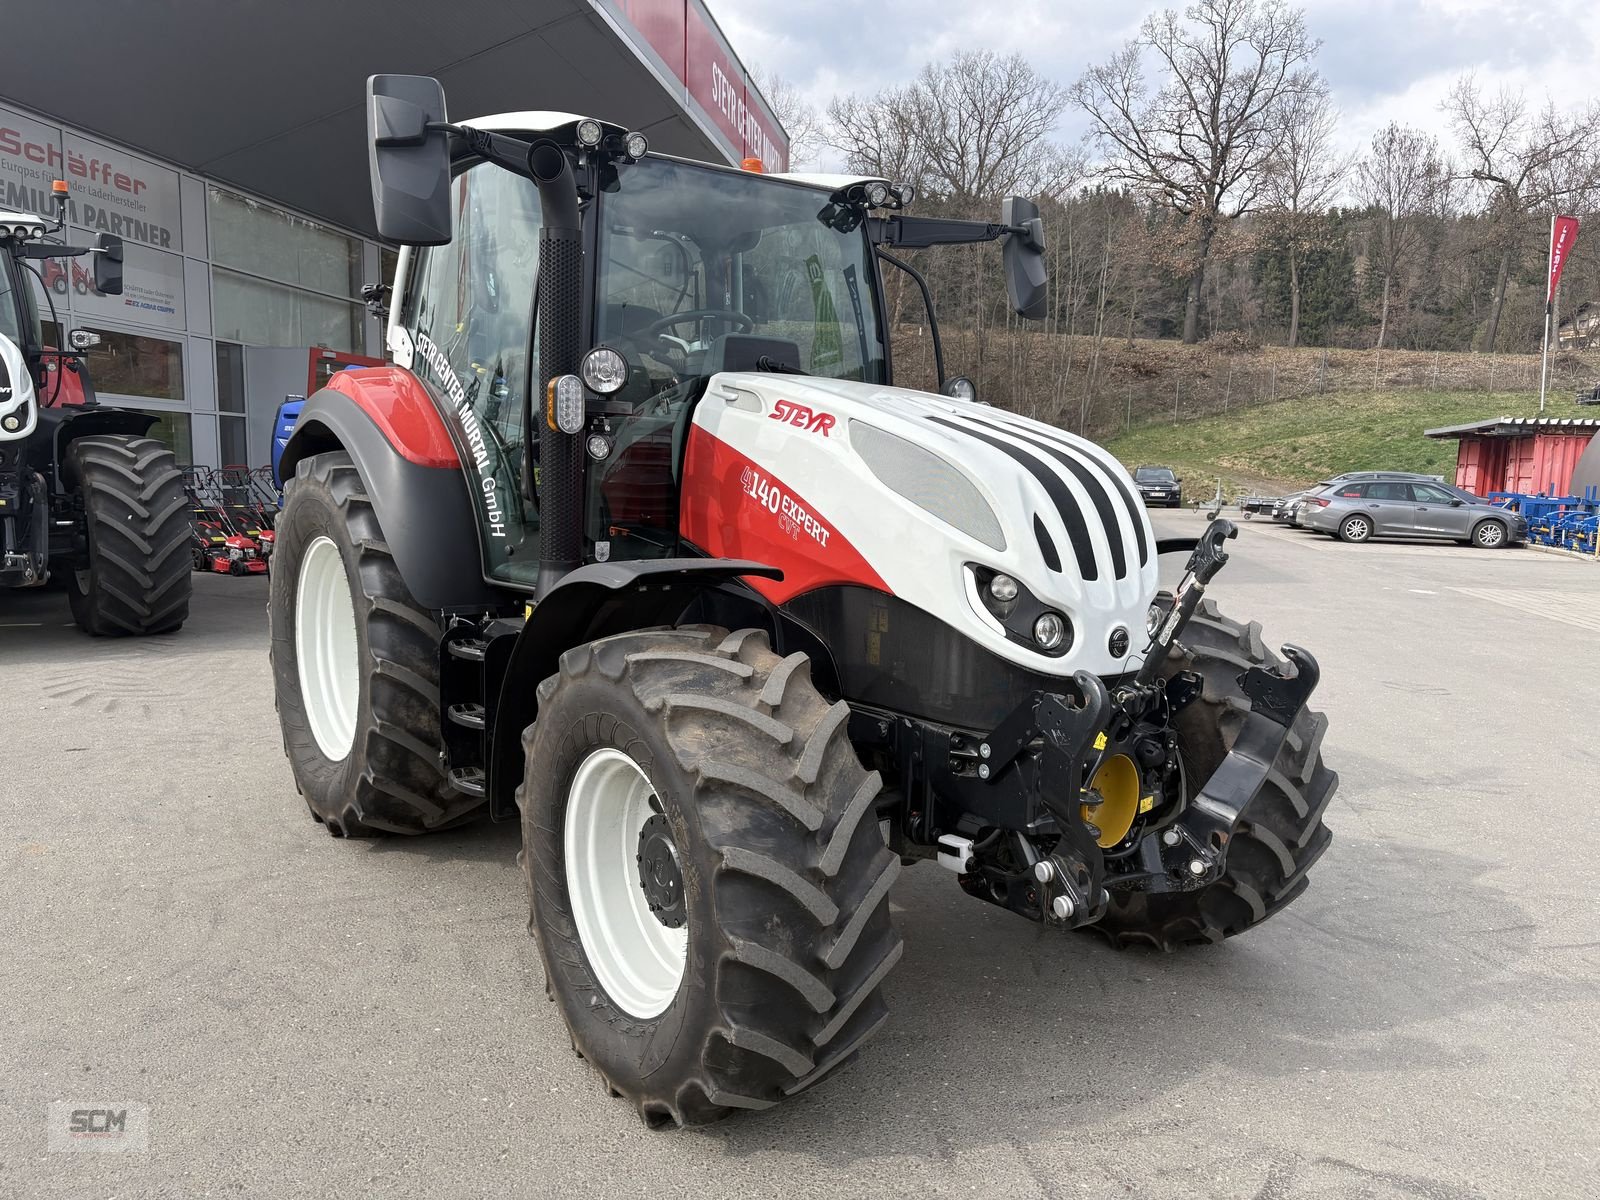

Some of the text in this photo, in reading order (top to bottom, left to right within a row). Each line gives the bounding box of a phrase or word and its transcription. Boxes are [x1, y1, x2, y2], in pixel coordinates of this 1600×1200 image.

[712, 61, 736, 128] STEYR
[737, 98, 762, 159] CENTER
[0, 127, 147, 195] Schäffer
[1, 158, 40, 179] Europas
[88, 186, 147, 213] Laderhersteller
[83, 203, 171, 248] PARTNER
[416, 332, 506, 537] STEYR CENTER MURTAL GmbH
[768, 399, 836, 437] STEYR
[740, 465, 830, 548] 4140 EXPERT
[778, 512, 801, 541] CVT
